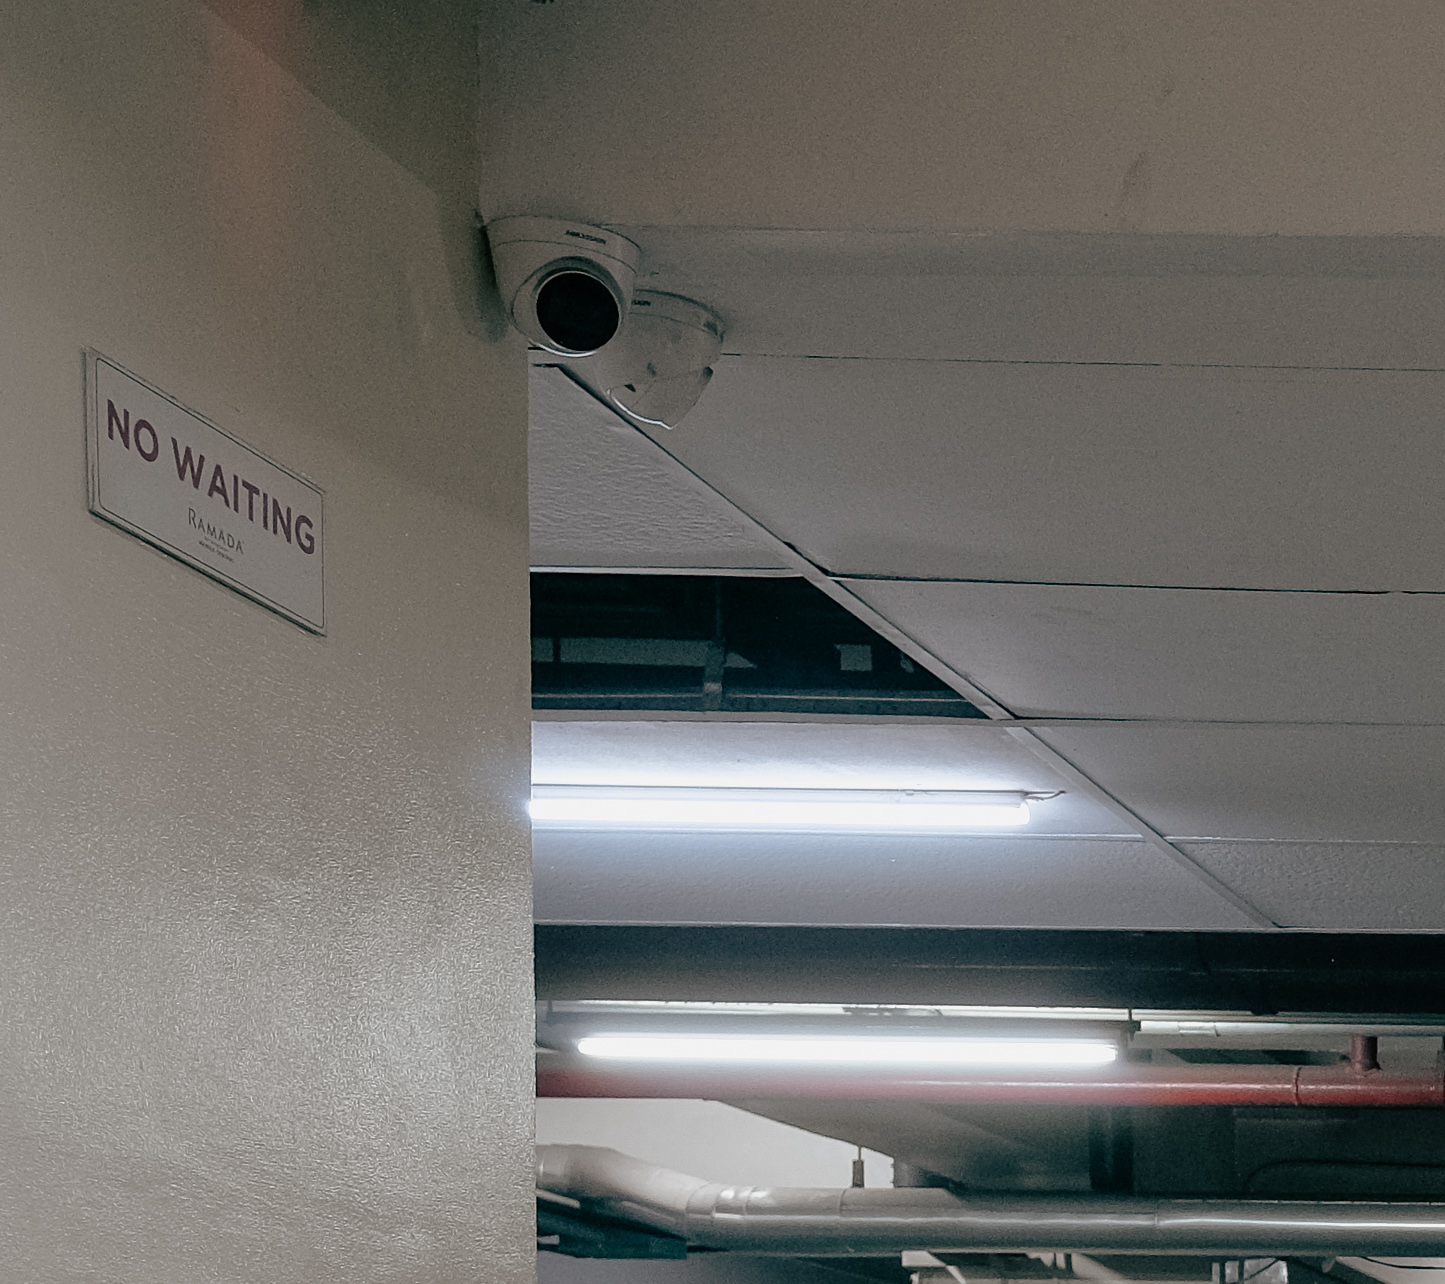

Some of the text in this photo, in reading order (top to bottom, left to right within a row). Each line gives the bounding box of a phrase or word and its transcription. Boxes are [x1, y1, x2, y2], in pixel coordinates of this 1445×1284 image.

[106, 399, 315, 555] NO WAITING
[188, 507, 244, 555] RAMADA
